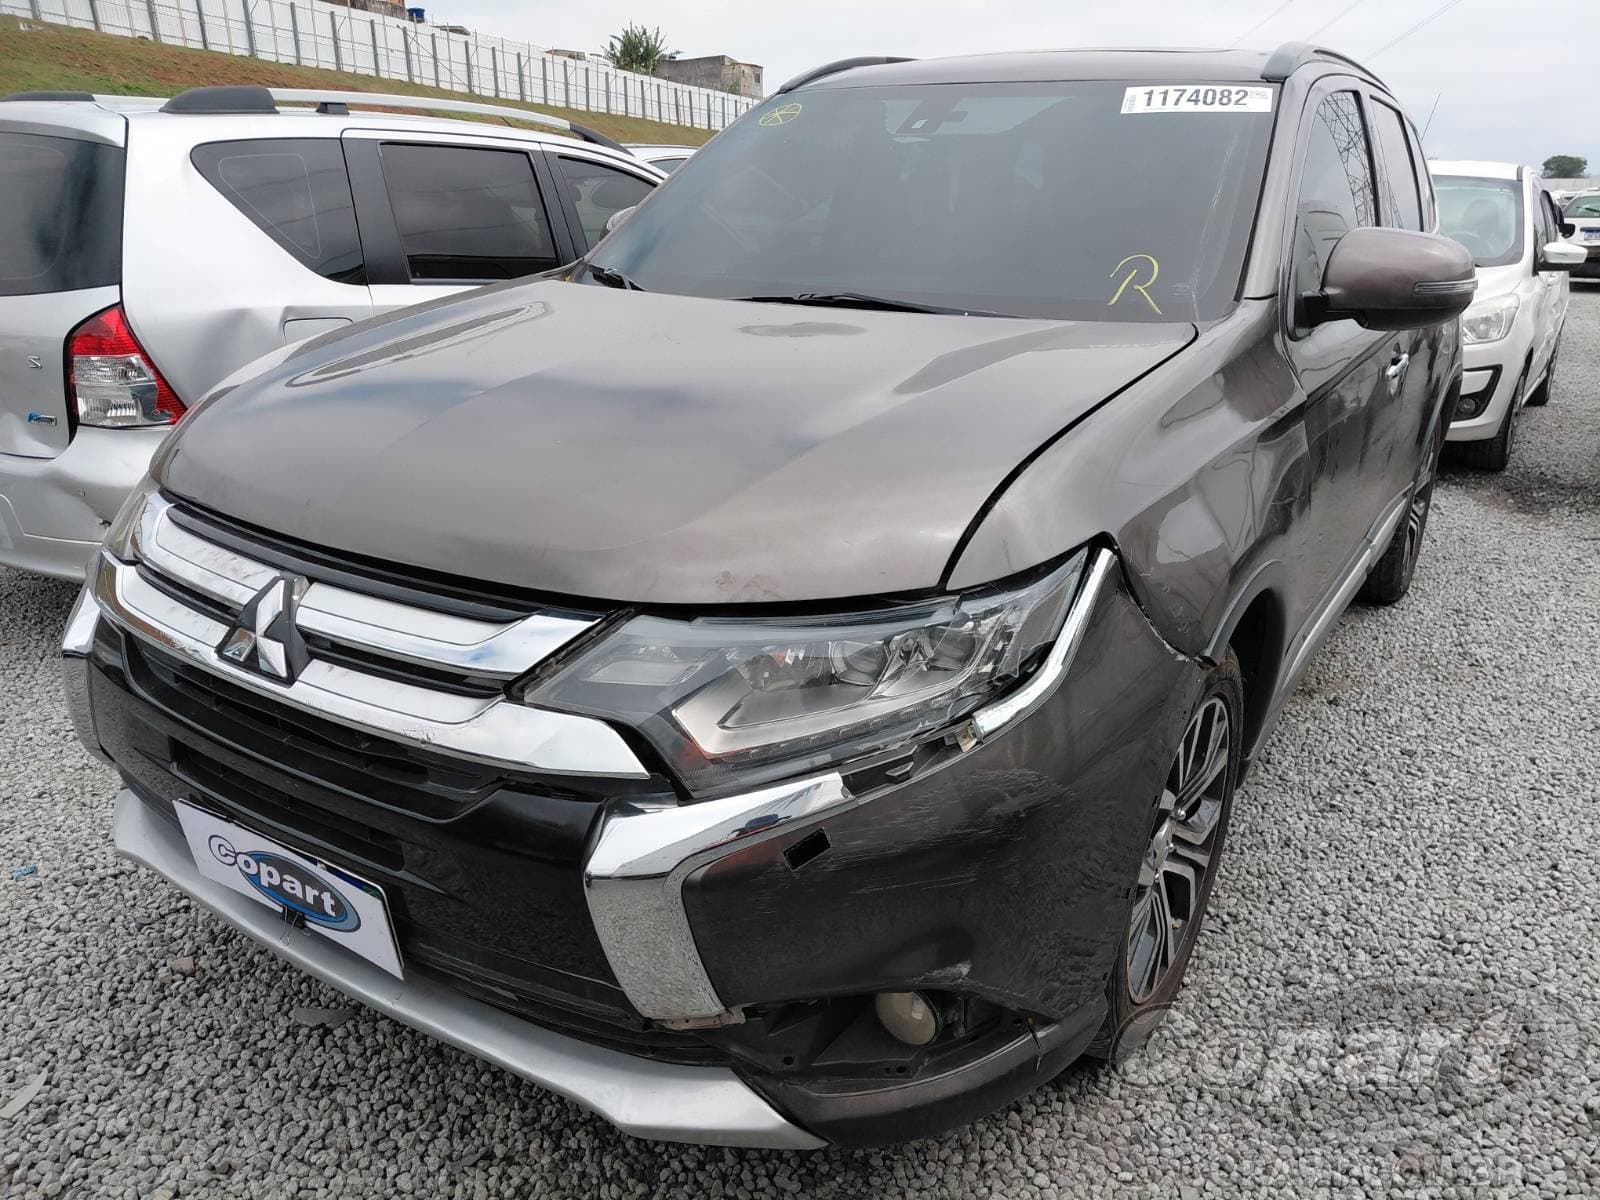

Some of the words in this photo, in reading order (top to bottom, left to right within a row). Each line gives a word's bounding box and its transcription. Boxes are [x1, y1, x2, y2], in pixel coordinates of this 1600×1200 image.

[1143, 88, 1250, 107] 1174082
[1107, 253, 1163, 315] R
[208, 834, 337, 918] Copart
